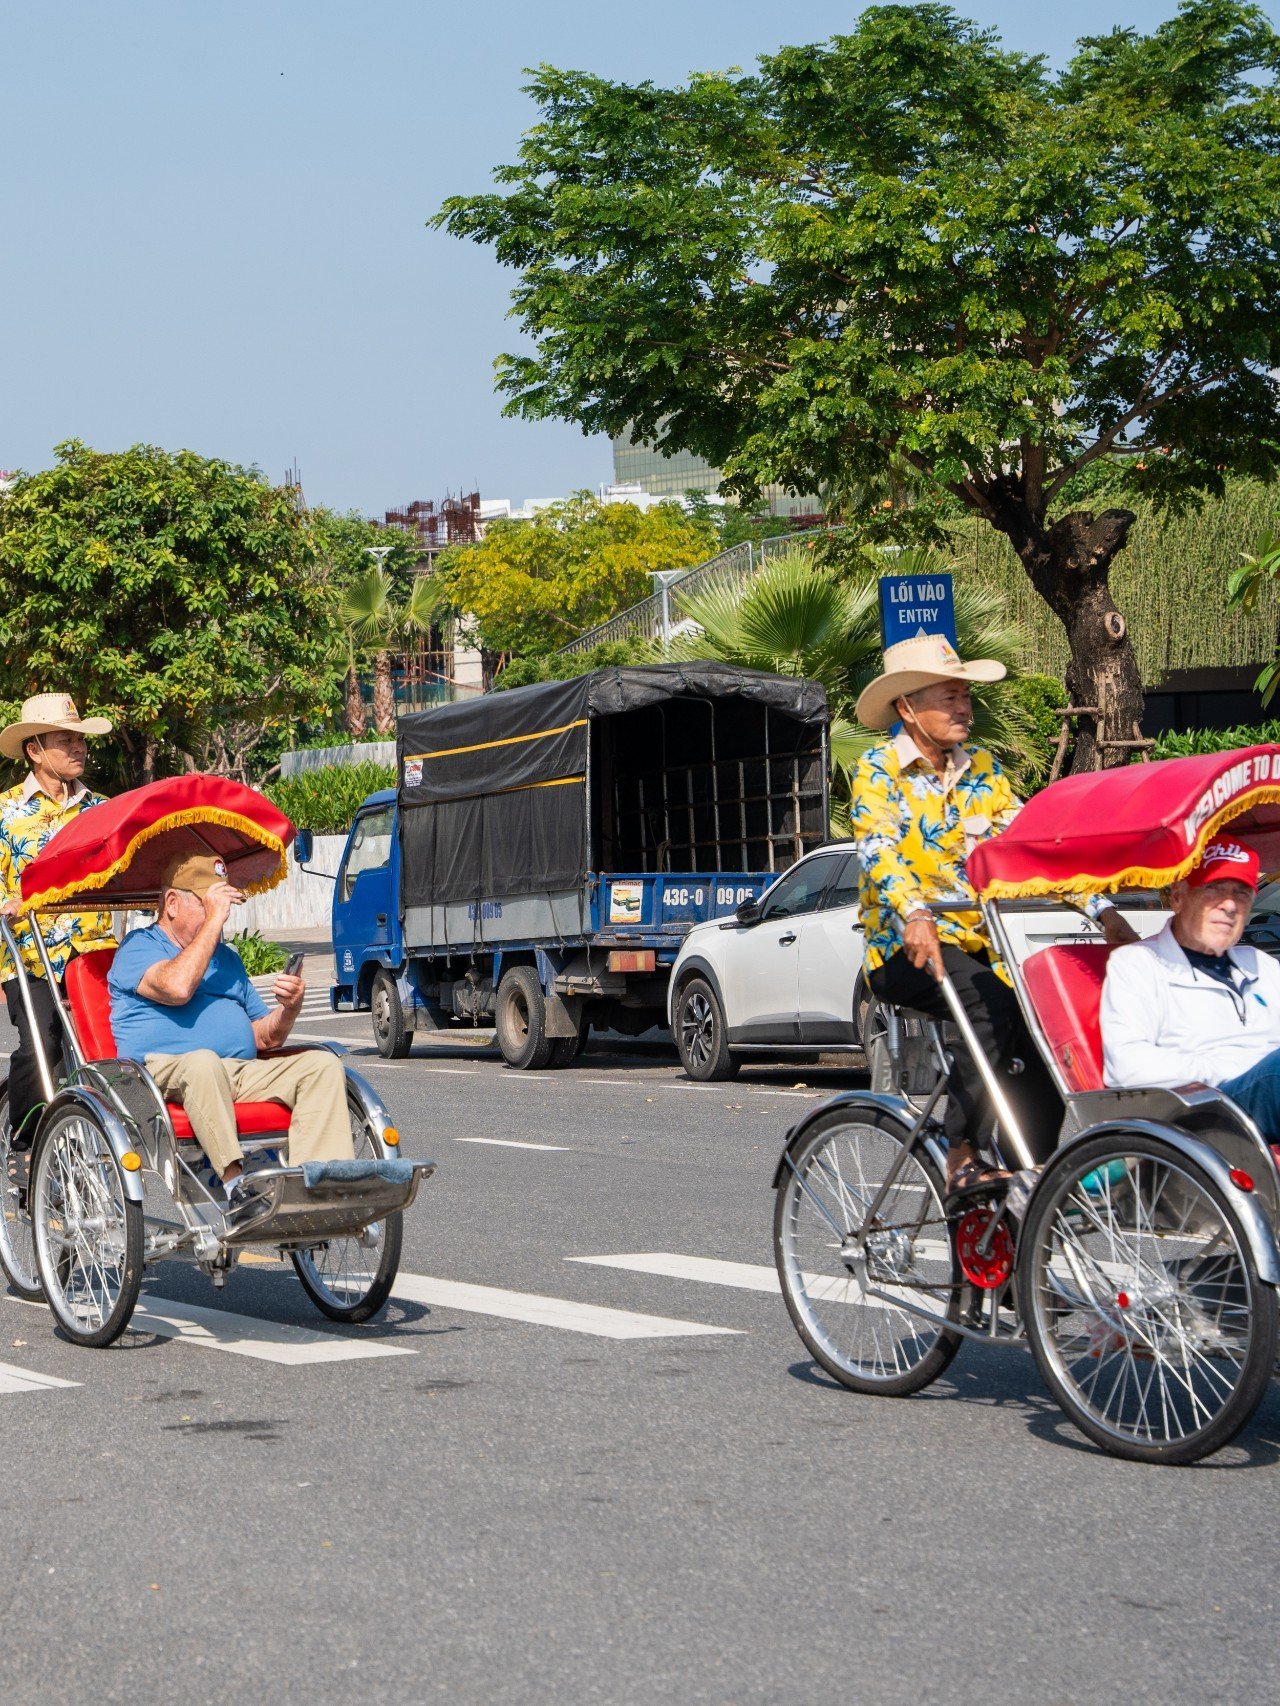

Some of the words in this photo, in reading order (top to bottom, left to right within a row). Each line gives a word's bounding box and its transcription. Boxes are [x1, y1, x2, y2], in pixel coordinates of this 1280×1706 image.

[890, 580, 914, 603] LỐI
[917, 580, 946, 602] VÀO
[898, 608, 939, 624] ENTRY
[1183, 759, 1253, 846] WELCOME
[1253, 754, 1271, 782] TO
[663, 888, 704, 906] 43C-0
